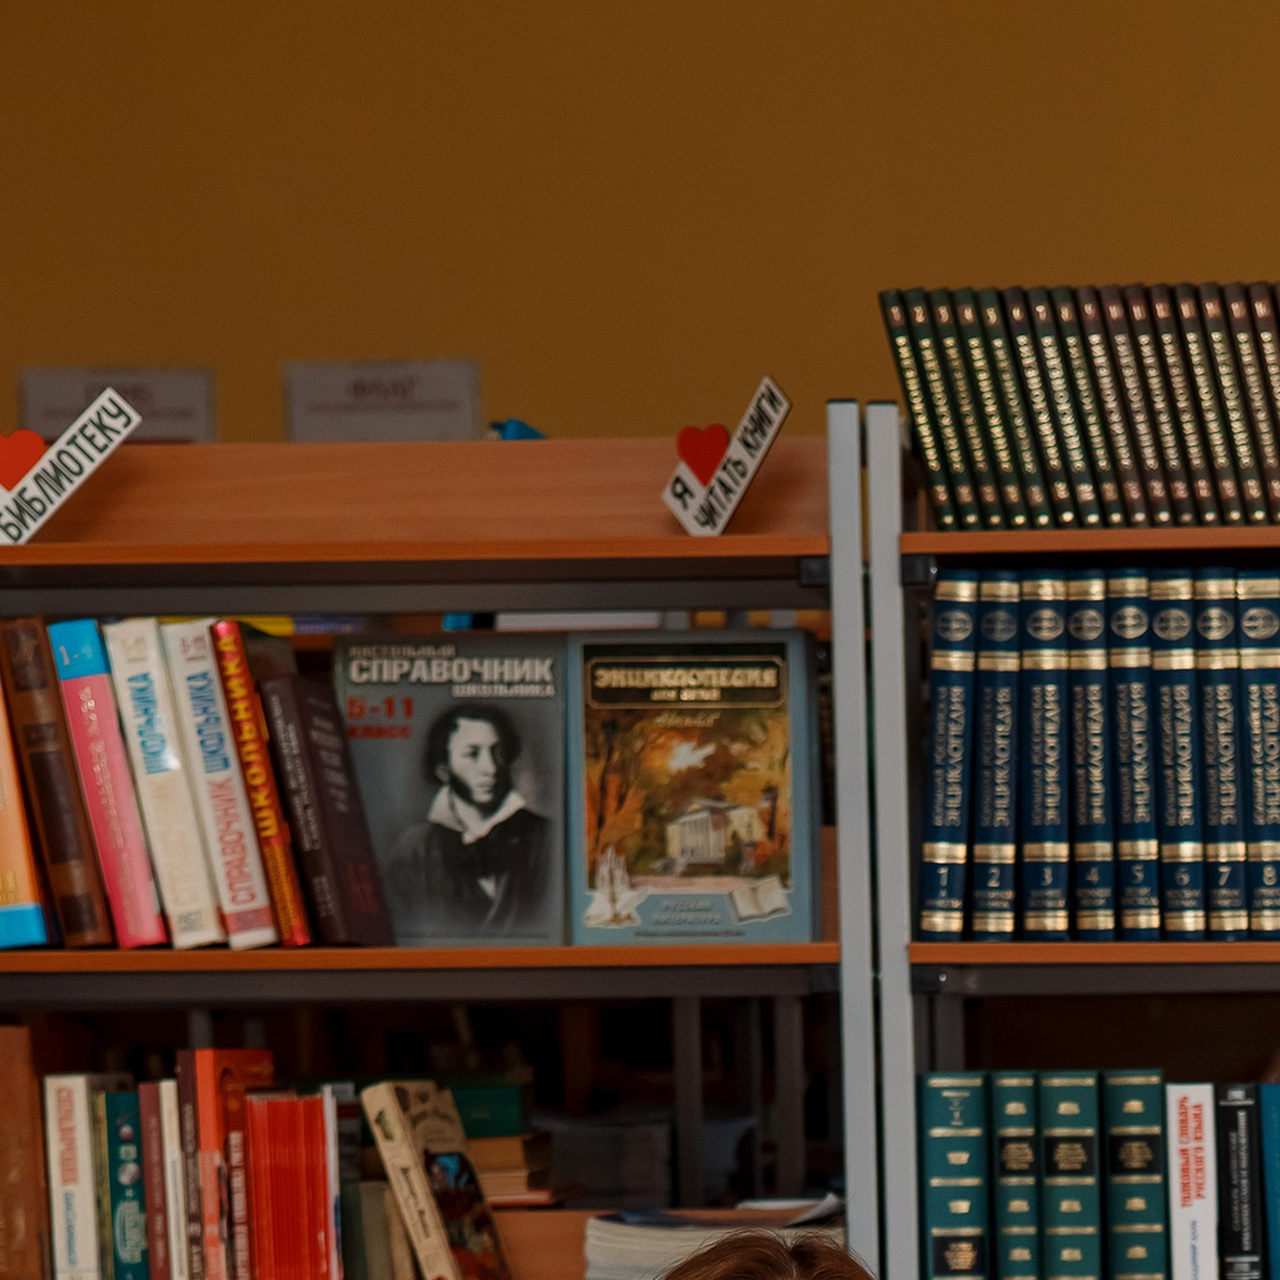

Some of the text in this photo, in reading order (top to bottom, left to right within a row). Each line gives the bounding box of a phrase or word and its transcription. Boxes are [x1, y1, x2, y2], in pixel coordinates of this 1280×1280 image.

[671, 476, 695, 510] Я
[693, 383, 784, 530] ЧИТАТЬ КНИГИ
[350, 657, 554, 684] СПРАВОЧНИК
[594, 668, 778, 688] ЭНЦИКЛОПЕДИЯ
[217, 635, 279, 838] ШКОЛЬНИКА
[944, 685, 966, 826] ЭНЦИКЛОПЕДИЯ
[993, 686, 1012, 827] ЭНЦИКЛОПЕДИЯ
[1044, 684, 1061, 825] ЭНЦИКЛОПЕДИЯ
[1087, 684, 1106, 824] ЭНЦИКЛОПЕДИЯ
[1131, 682, 1150, 823] ЭНЦИКЛОПЕДИЯ
[1174, 684, 1194, 826] ЭНЦИКЛОПЕДИЯ
[1216, 684, 1237, 825] ЭНЦИКЛОПЕДИЯ
[187, 671, 257, 904] СПРАВОЧНИК ШКОЛЬНИКА
[937, 867, 949, 887] 1
[987, 867, 1001, 888] 2
[1041, 867, 1053, 886] 3
[1086, 867, 1099, 884] 4
[1131, 864, 1144, 884] 5
[1175, 867, 1190, 885] 6
[1218, 866, 1232, 885] 7
[1263, 866, 1276, 885] 8
[1177, 1095, 1193, 1207] ТОЛКОВЫЙ СЛОВАРЬ
[1192, 1104, 1205, 1199] РУССКОГО ЯЗЫКА
